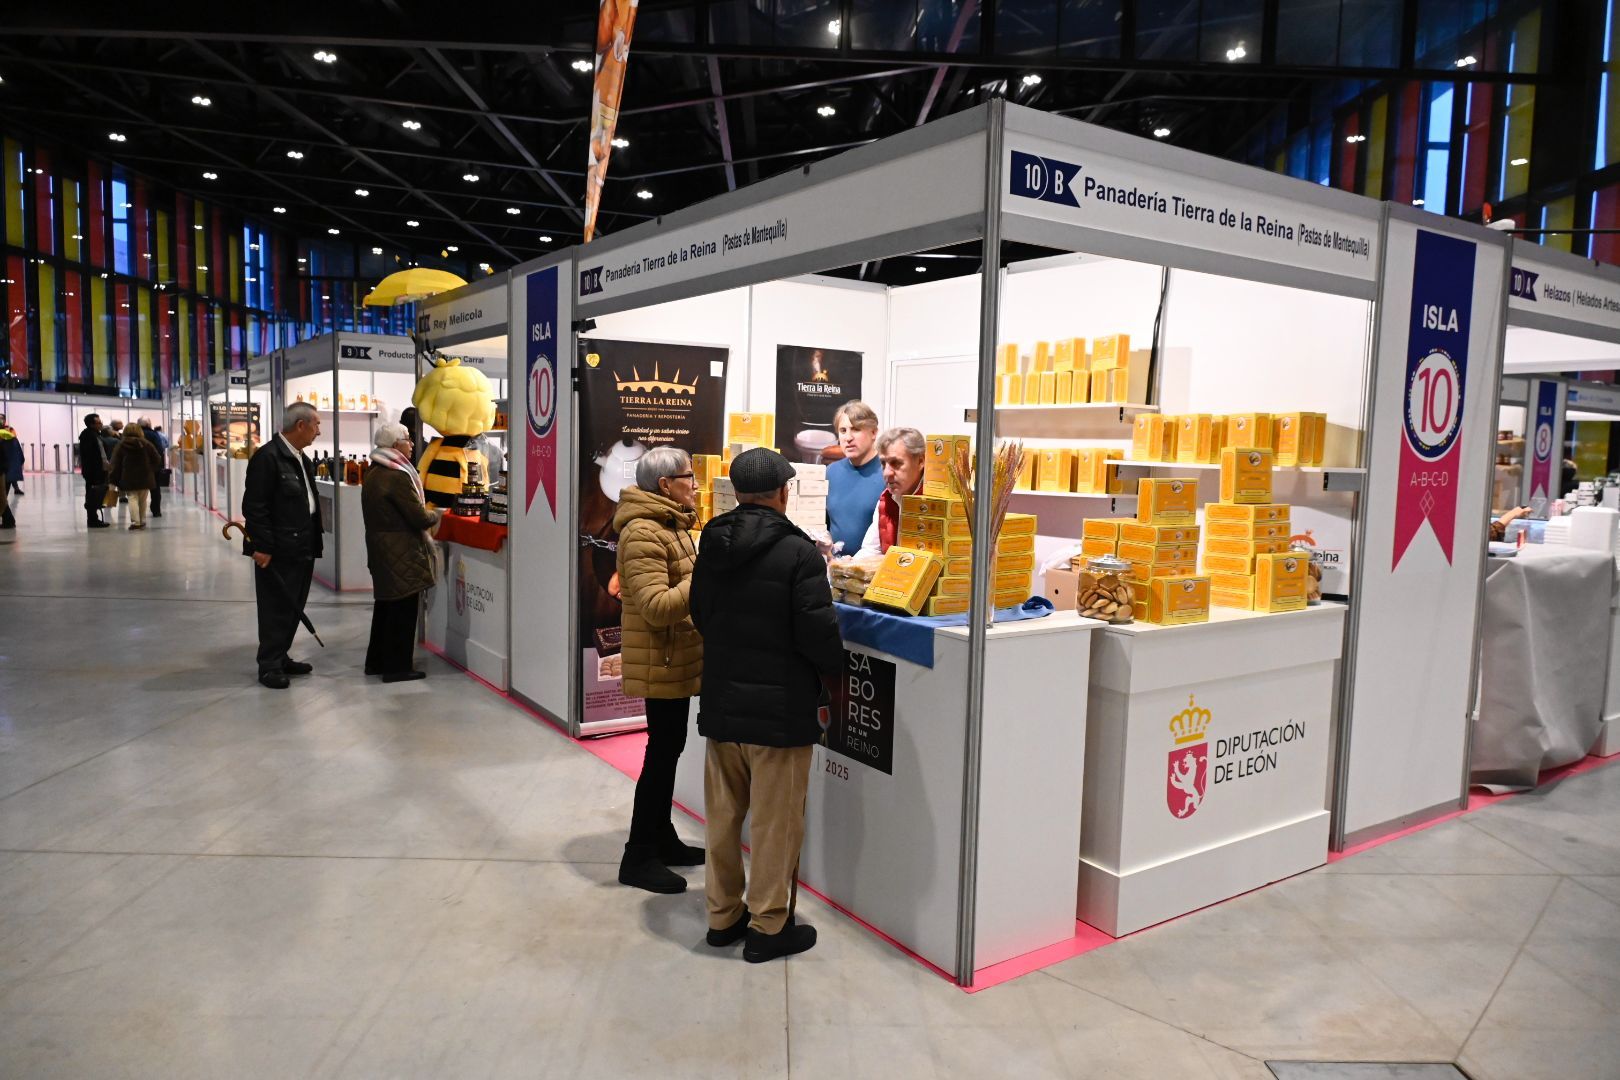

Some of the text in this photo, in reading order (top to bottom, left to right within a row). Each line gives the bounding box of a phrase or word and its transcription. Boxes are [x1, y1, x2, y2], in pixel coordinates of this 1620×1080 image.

[1025, 163, 1041, 191] 10
[1054, 169, 1064, 195] B
[1084, 176, 1167, 214] Panadería
[1172, 196, 1215, 224] Tierra
[1218, 204, 1237, 228] de
[1240, 208, 1252, 232] la
[1256, 214, 1294, 240] Reina
[1323, 228, 1332, 249] de
[605, 260, 641, 282] Panadería
[642, 256, 665, 272] Tierra
[667, 251, 678, 265] de
[680, 248, 688, 262] la
[690, 241, 716, 260] Reina
[743, 228, 751, 245] de
[1514, 273, 1522, 292] 10
[1525, 277, 1531, 294] A
[1543, 282, 1571, 303] Helazos
[433, 319, 447, 329] Rey
[449, 308, 482, 326] Melicola
[532, 321, 551, 342] ISLA
[1423, 304, 1459, 333] ISLA
[532, 367, 550, 418] 10
[620, 396, 692, 407] TIERRA LA REINA
[797, 382, 841, 395] Tierra la Reina
[1418, 367, 1452, 434] 10
[1539, 429, 1548, 453] 8
[1410, 470, 1449, 487] A-B-C-D
[849, 650, 872, 676] SA
[848, 675, 875, 701] BO
[848, 701, 882, 731] RES
[848, 725, 868, 738] DE UN
[1215, 718, 1306, 759] DIPUTACIÓN
[847, 735, 880, 759] REINO
[825, 759, 849, 781] 2025
[1214, 749, 1278, 784] DE LEÓN
